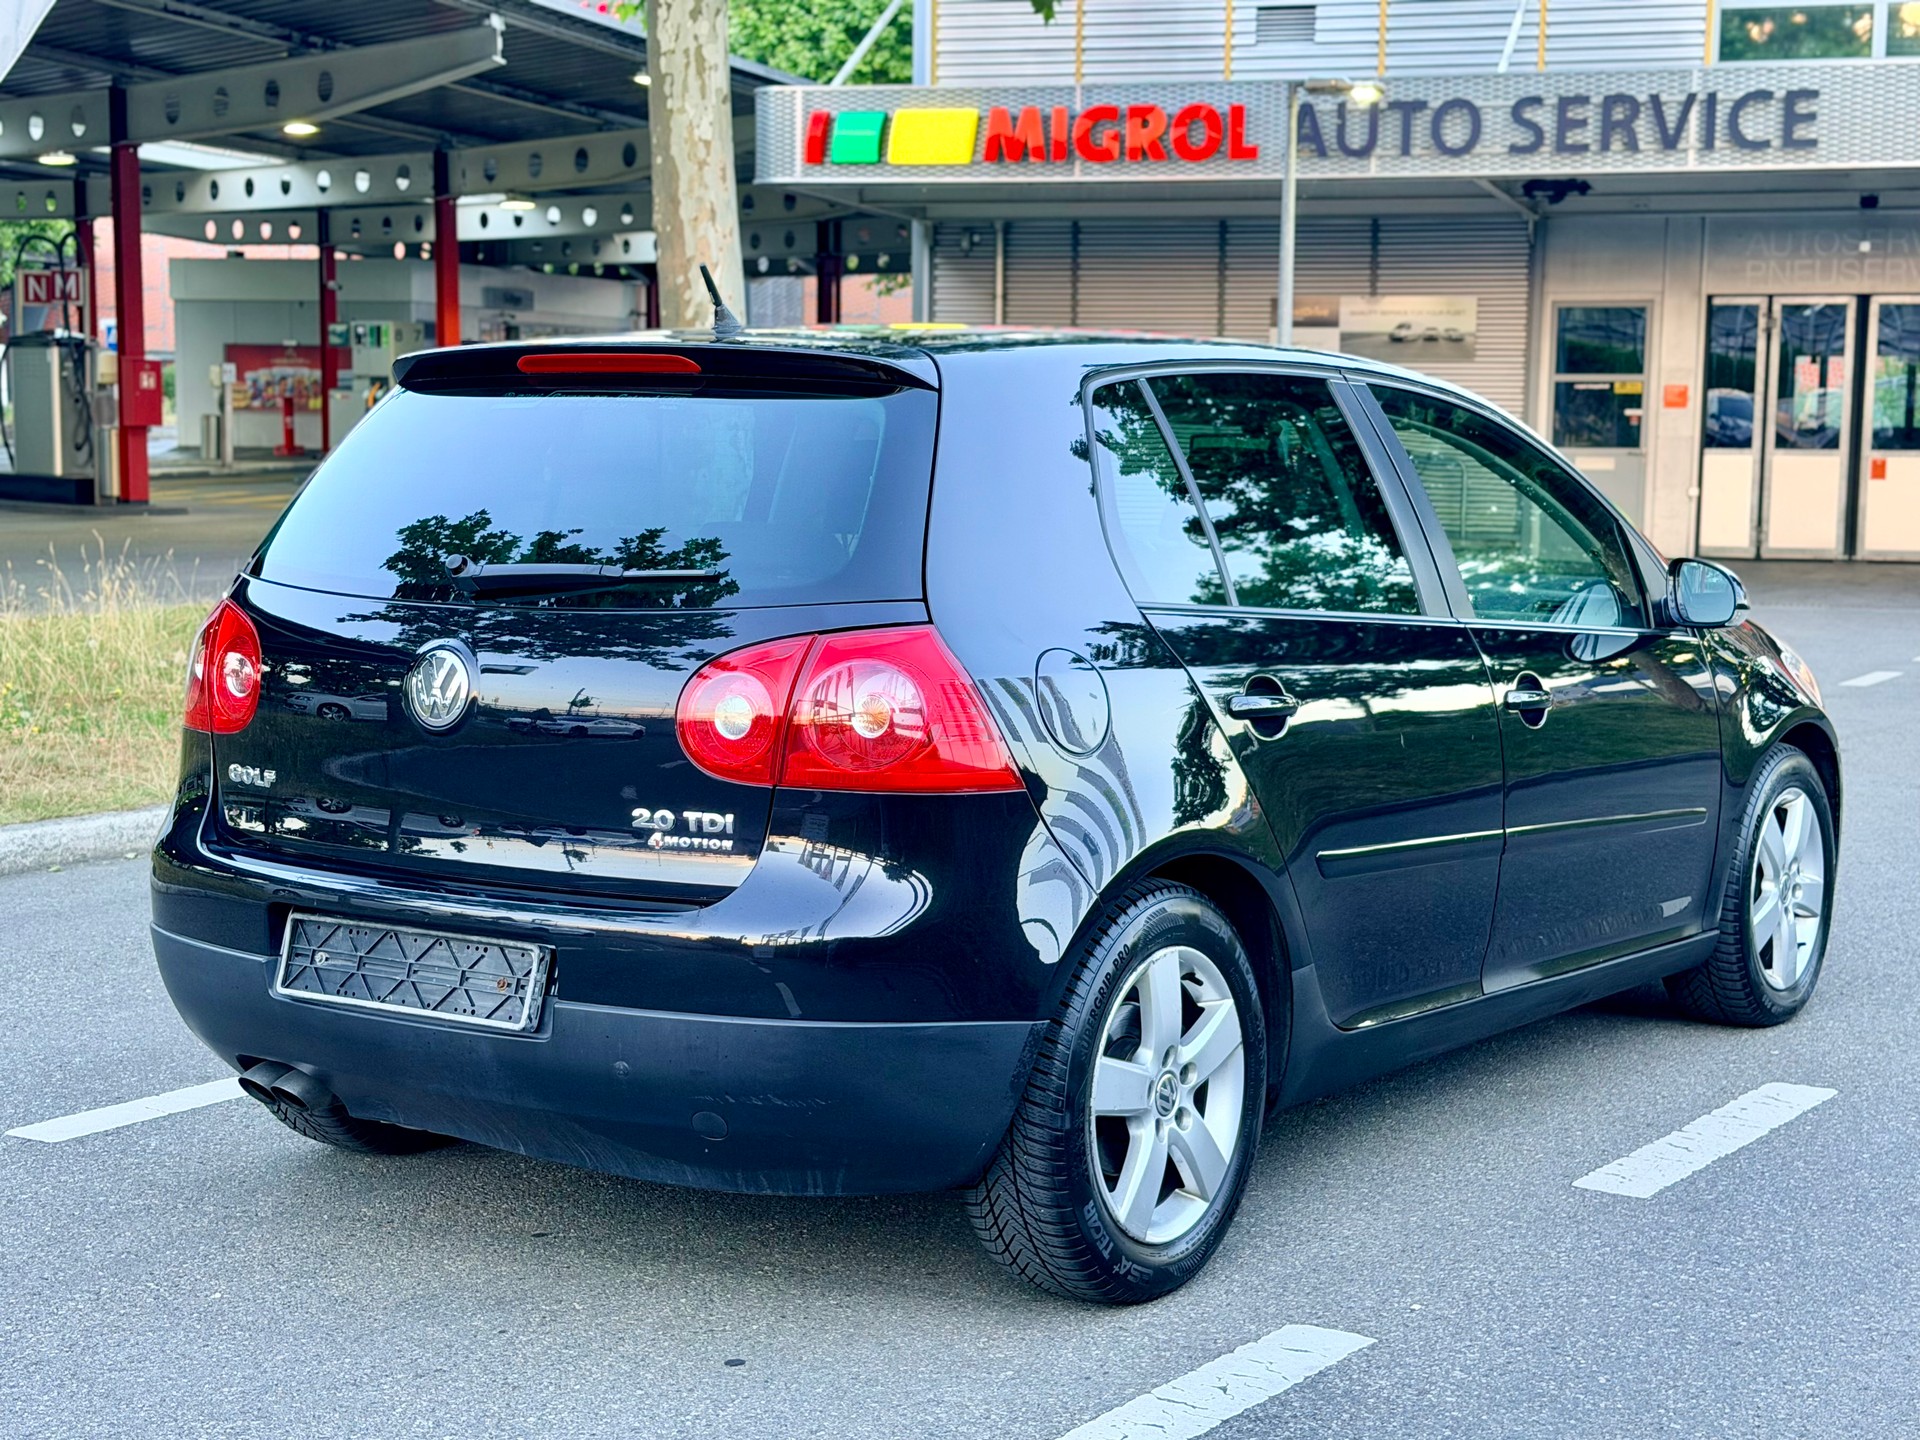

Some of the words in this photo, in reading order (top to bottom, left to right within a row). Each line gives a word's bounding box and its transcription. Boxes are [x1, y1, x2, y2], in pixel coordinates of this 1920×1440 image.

[983, 103, 1260, 164] MIGROL
[1297, 97, 1483, 158] AUTO
[1509, 89, 1821, 154] SERVICE
[228, 763, 276, 788] GOLF
[647, 832, 734, 851] 4MOTION
[682, 811, 735, 834] TDI
[1079, 971, 1113, 1060] SUPERGRIP
[1112, 943, 1131, 971] PRO
[1083, 1199, 1115, 1260] TECAR
